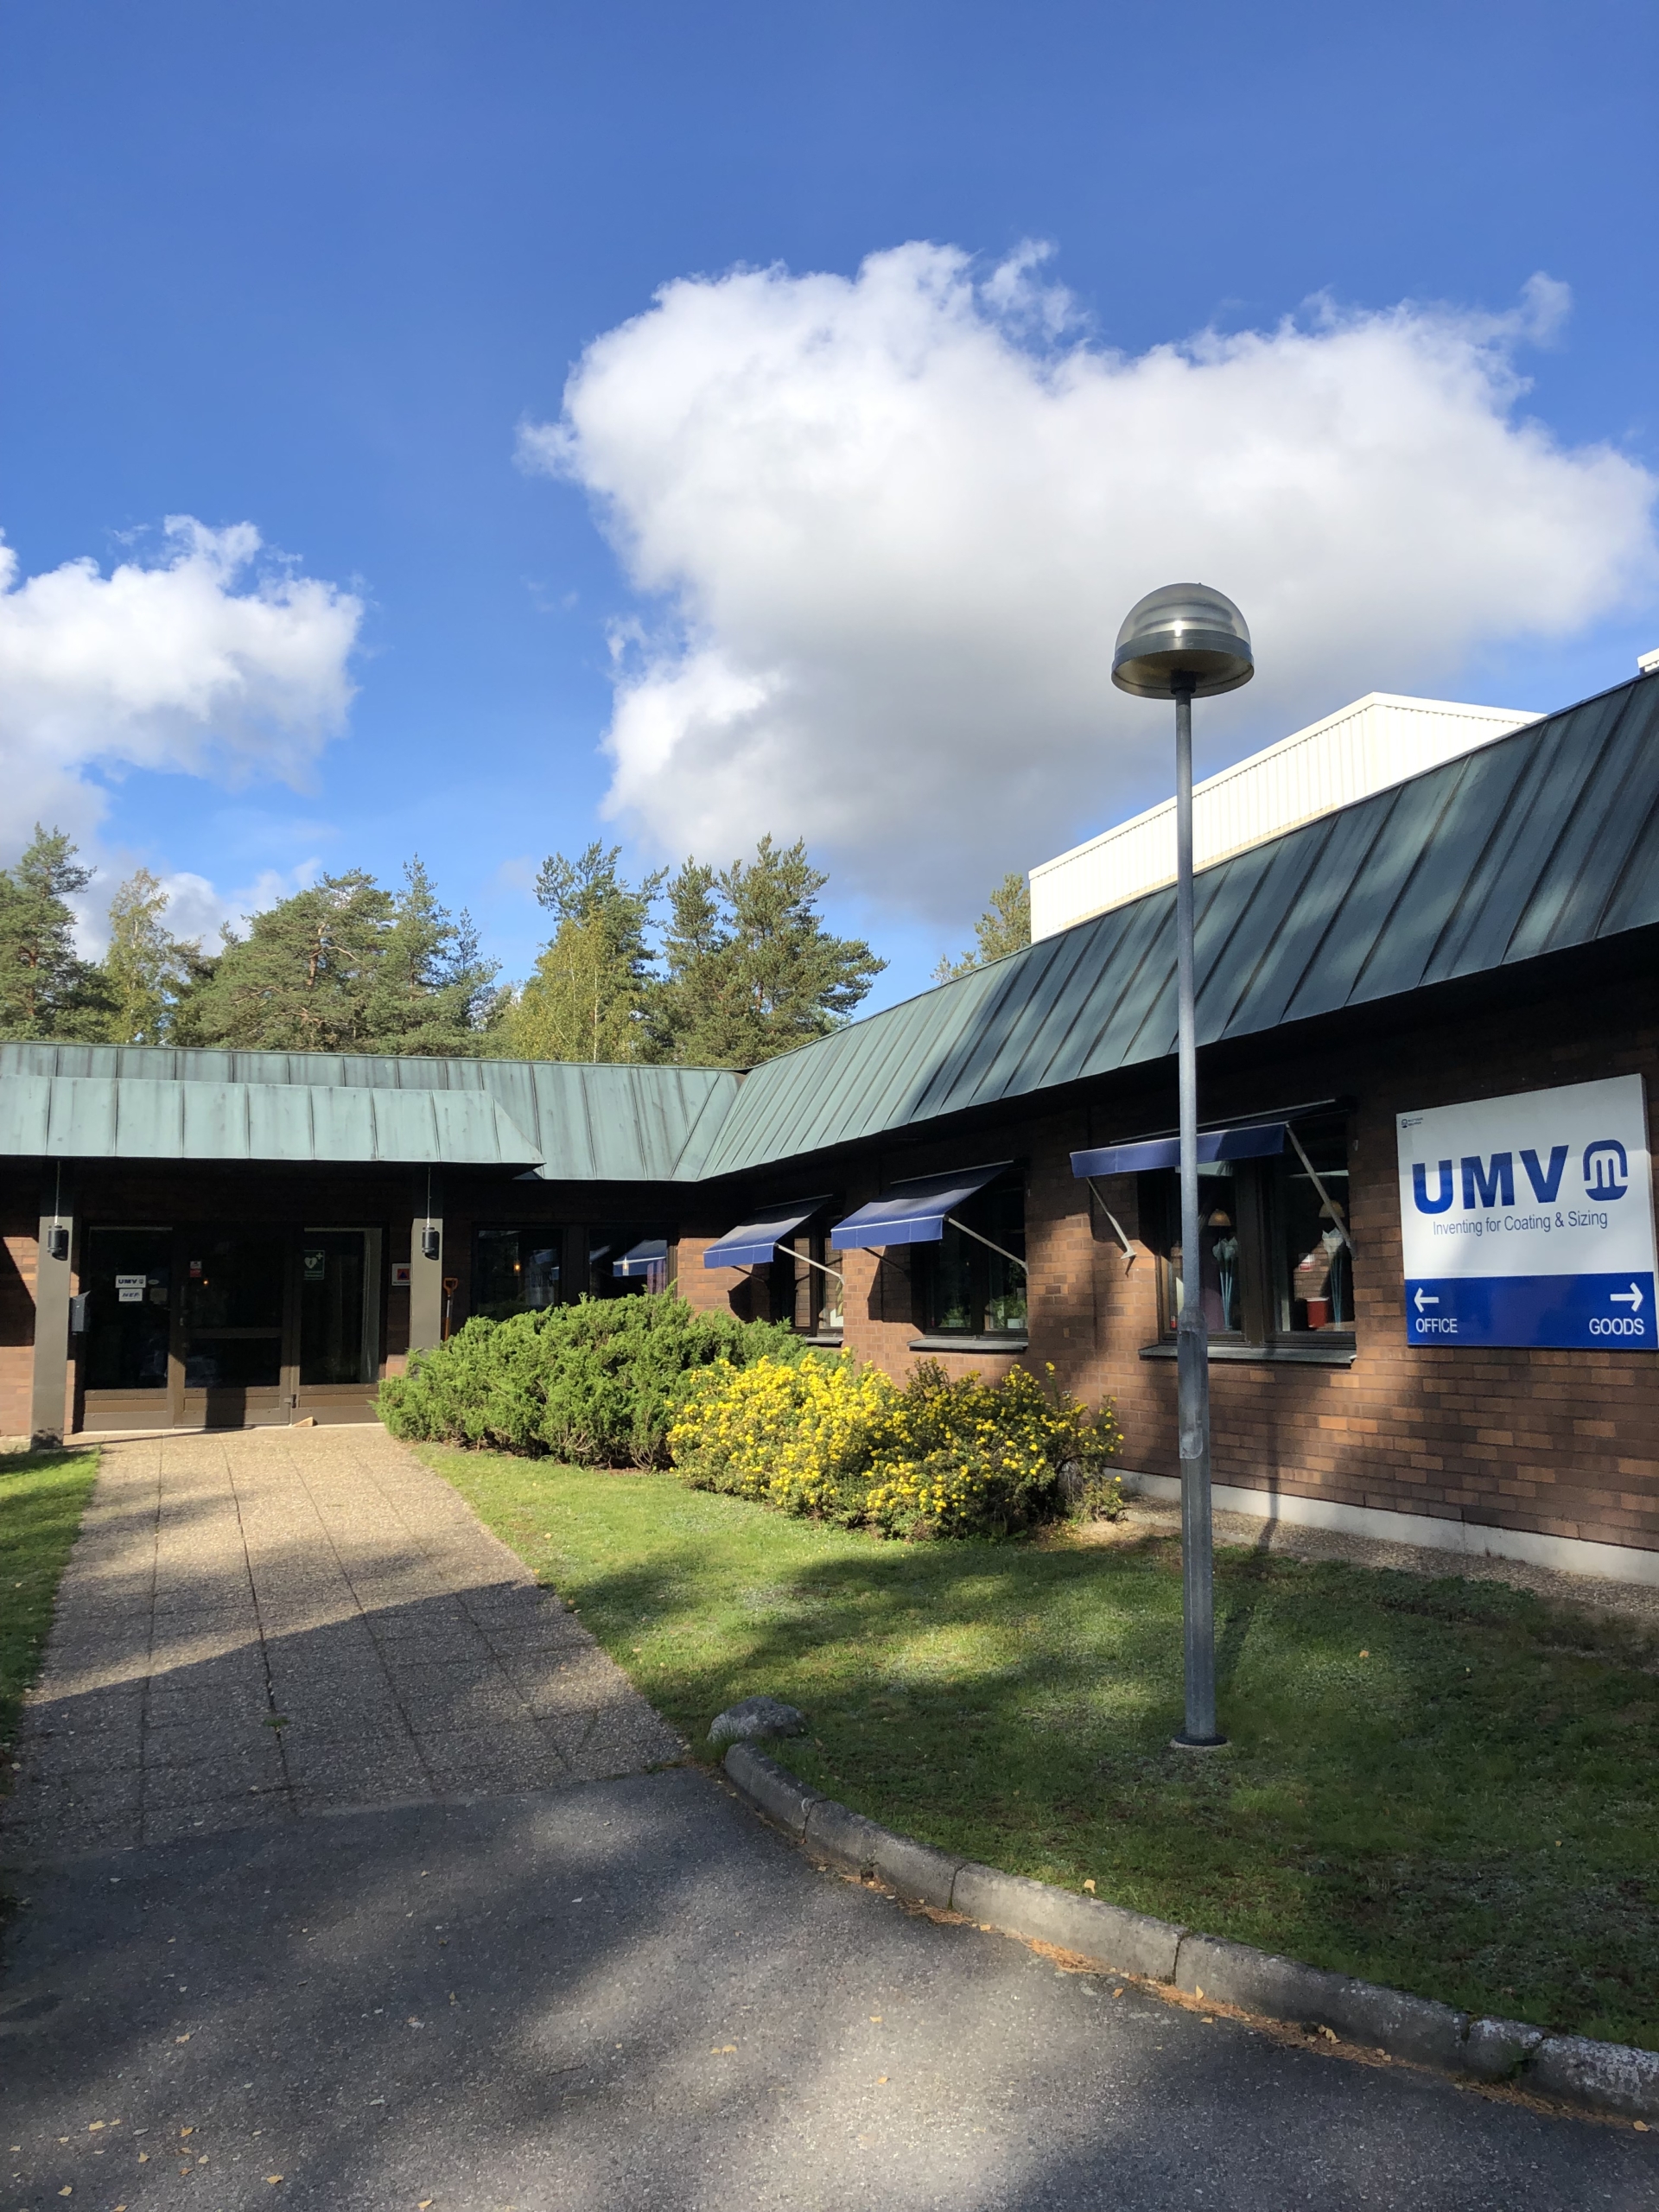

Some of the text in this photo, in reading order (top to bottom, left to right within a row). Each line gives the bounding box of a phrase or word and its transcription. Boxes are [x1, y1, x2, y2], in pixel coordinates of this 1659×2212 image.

[1412, 1144, 1569, 1215] UMV
[1433, 1211, 1608, 1236] Inventing for Coating & Sizing
[1415, 1318, 1458, 1333] OFFICE
[1588, 1318, 1644, 1335] GOODS
